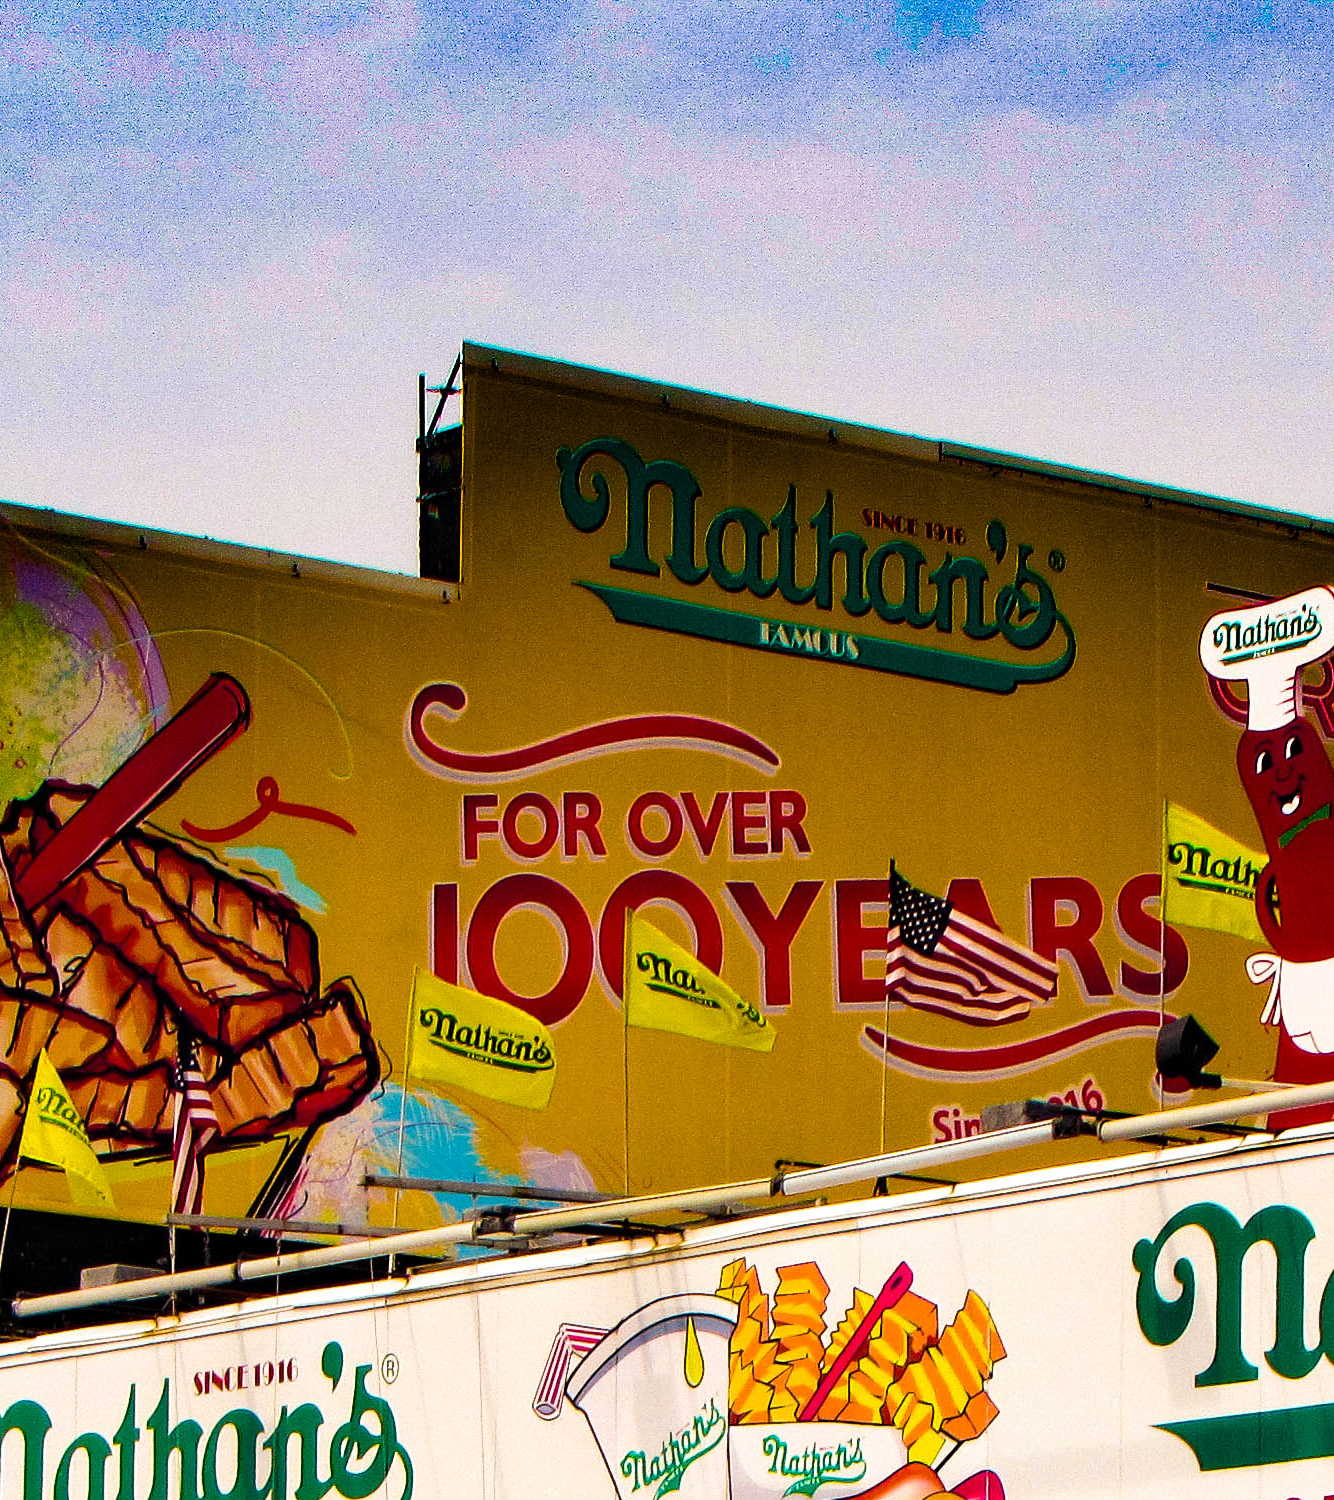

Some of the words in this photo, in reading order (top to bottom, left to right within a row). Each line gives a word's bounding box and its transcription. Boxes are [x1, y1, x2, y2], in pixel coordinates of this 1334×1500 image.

[556, 437, 1076, 655] Nathan's
[860, 507, 919, 537] SINCE
[924, 520, 967, 546] 1916
[757, 621, 861, 662] FAMOUS
[1213, 603, 1324, 656] Nathan's
[461, 791, 609, 864] FOR
[625, 789, 812, 861] OVER
[419, 1006, 555, 1065] Nathan's
[193, 1366, 254, 1397] SINCE
[253, 1356, 300, 1390] 1916
[762, 1433, 868, 1482] Nathan's
